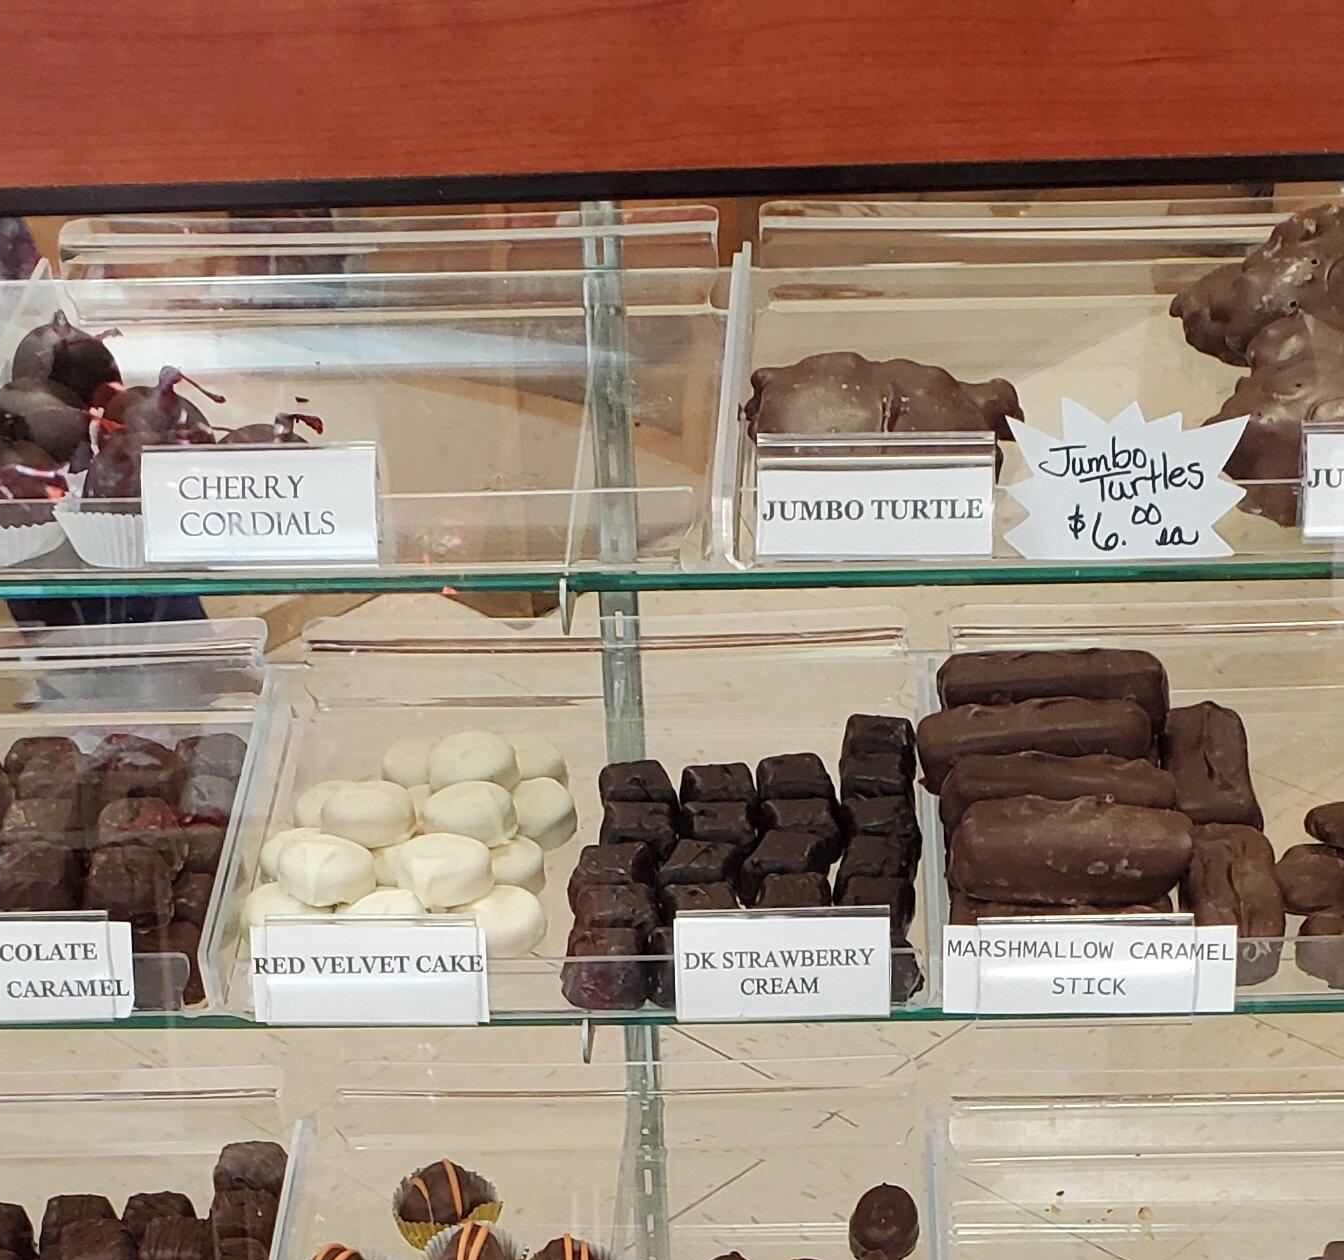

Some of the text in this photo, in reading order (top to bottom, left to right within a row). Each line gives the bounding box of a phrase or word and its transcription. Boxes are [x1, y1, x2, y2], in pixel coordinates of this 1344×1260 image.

[1039, 436, 1146, 477] Jumbo
[179, 475, 304, 500] CHERRY
[1079, 452, 1204, 502] Turtles
[762, 498, 983, 521] JUMBO TURTLE
[180, 511, 335, 537] CORDIALS
[684, 948, 875, 971] DK STRAWBERRY
[947, 939, 1235, 962] MARSHMALLOW CARAMEL
[254, 953, 484, 975] RED VELVET CAKE
[6, 978, 131, 998] CARAMEL
[740, 976, 820, 996] CREAM
[1052, 977, 1127, 996] STICK
